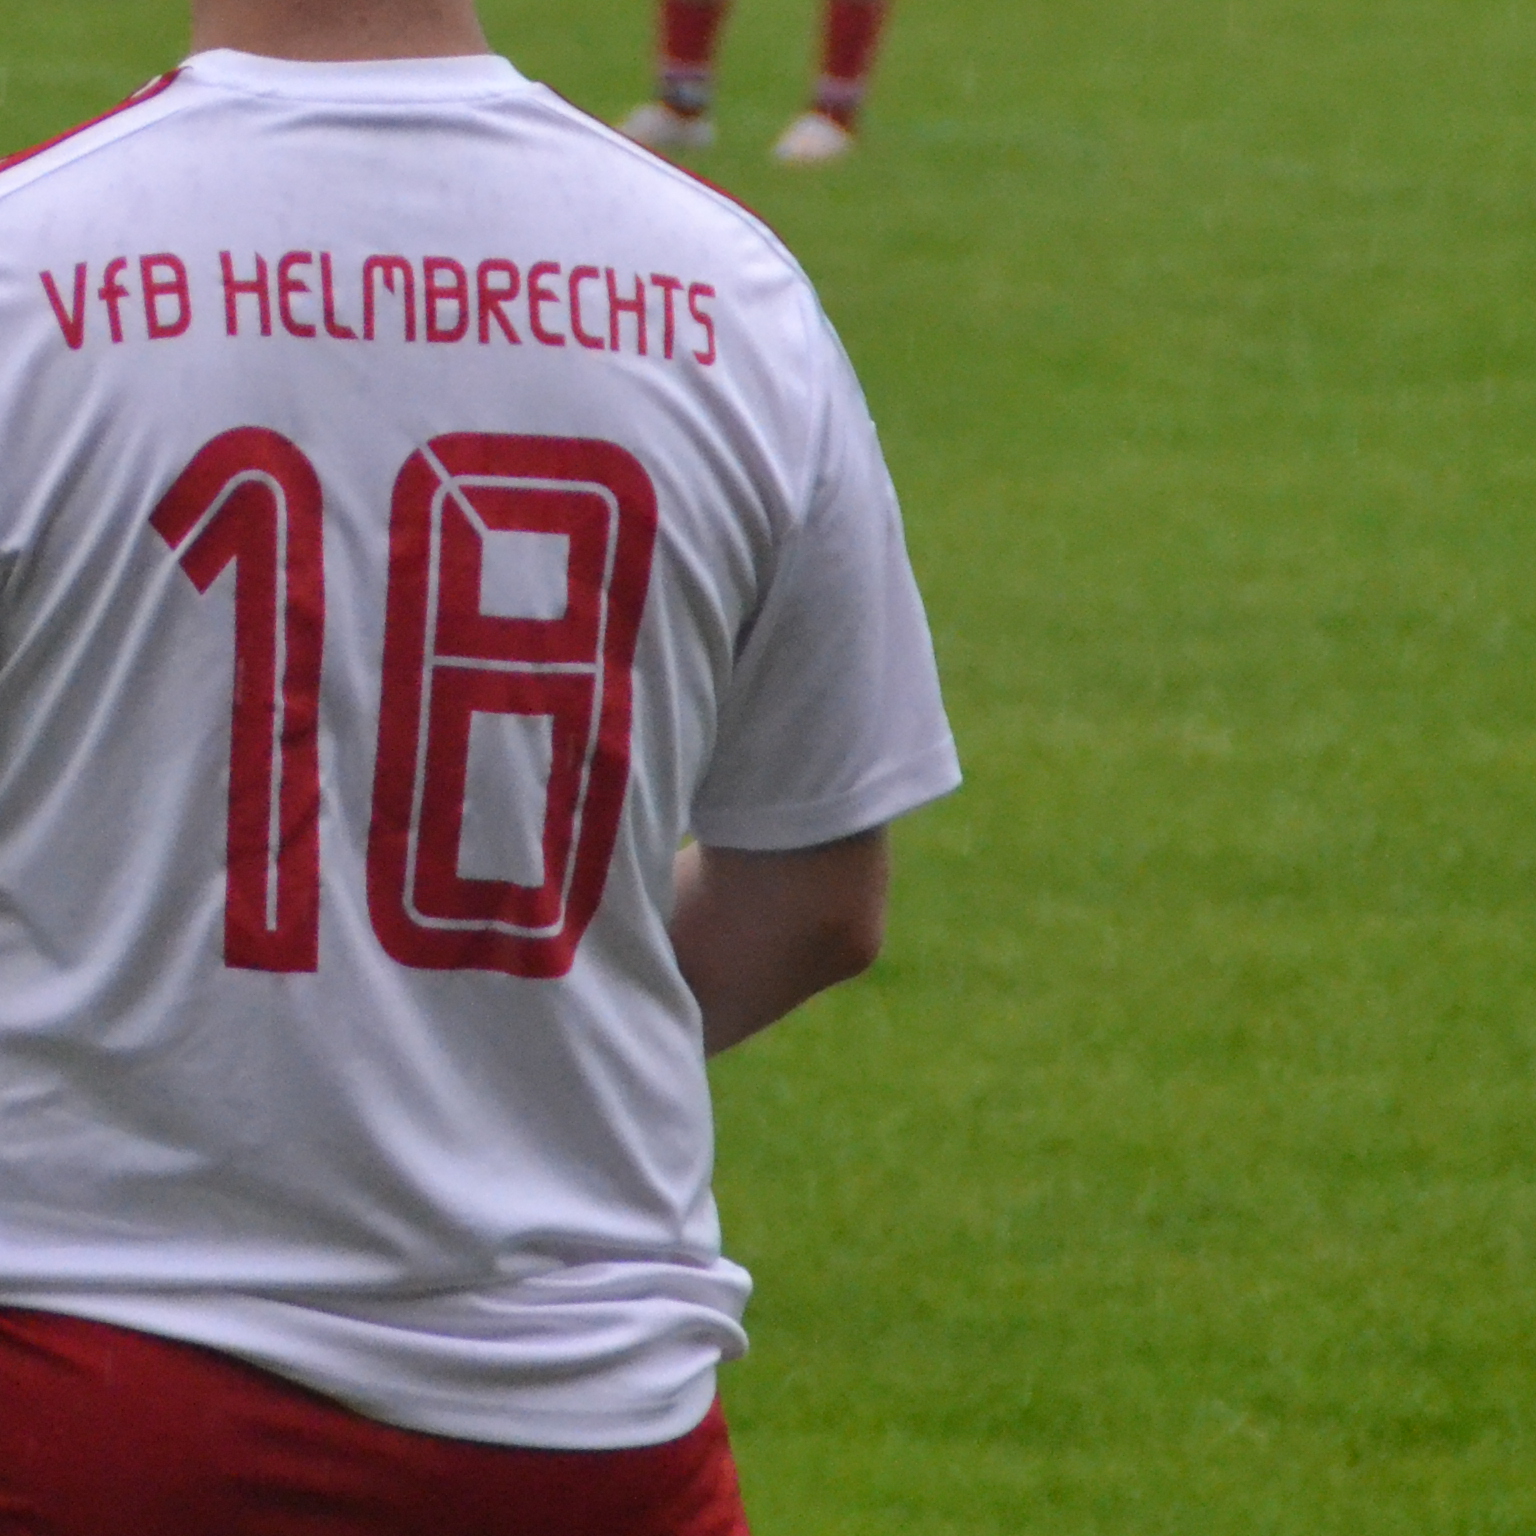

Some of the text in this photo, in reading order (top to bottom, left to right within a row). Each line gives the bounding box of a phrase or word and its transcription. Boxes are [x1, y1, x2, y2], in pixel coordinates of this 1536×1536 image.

[39, 249, 719, 367] VfB HELMBRECHTS
[148, 425, 659, 980] 18
